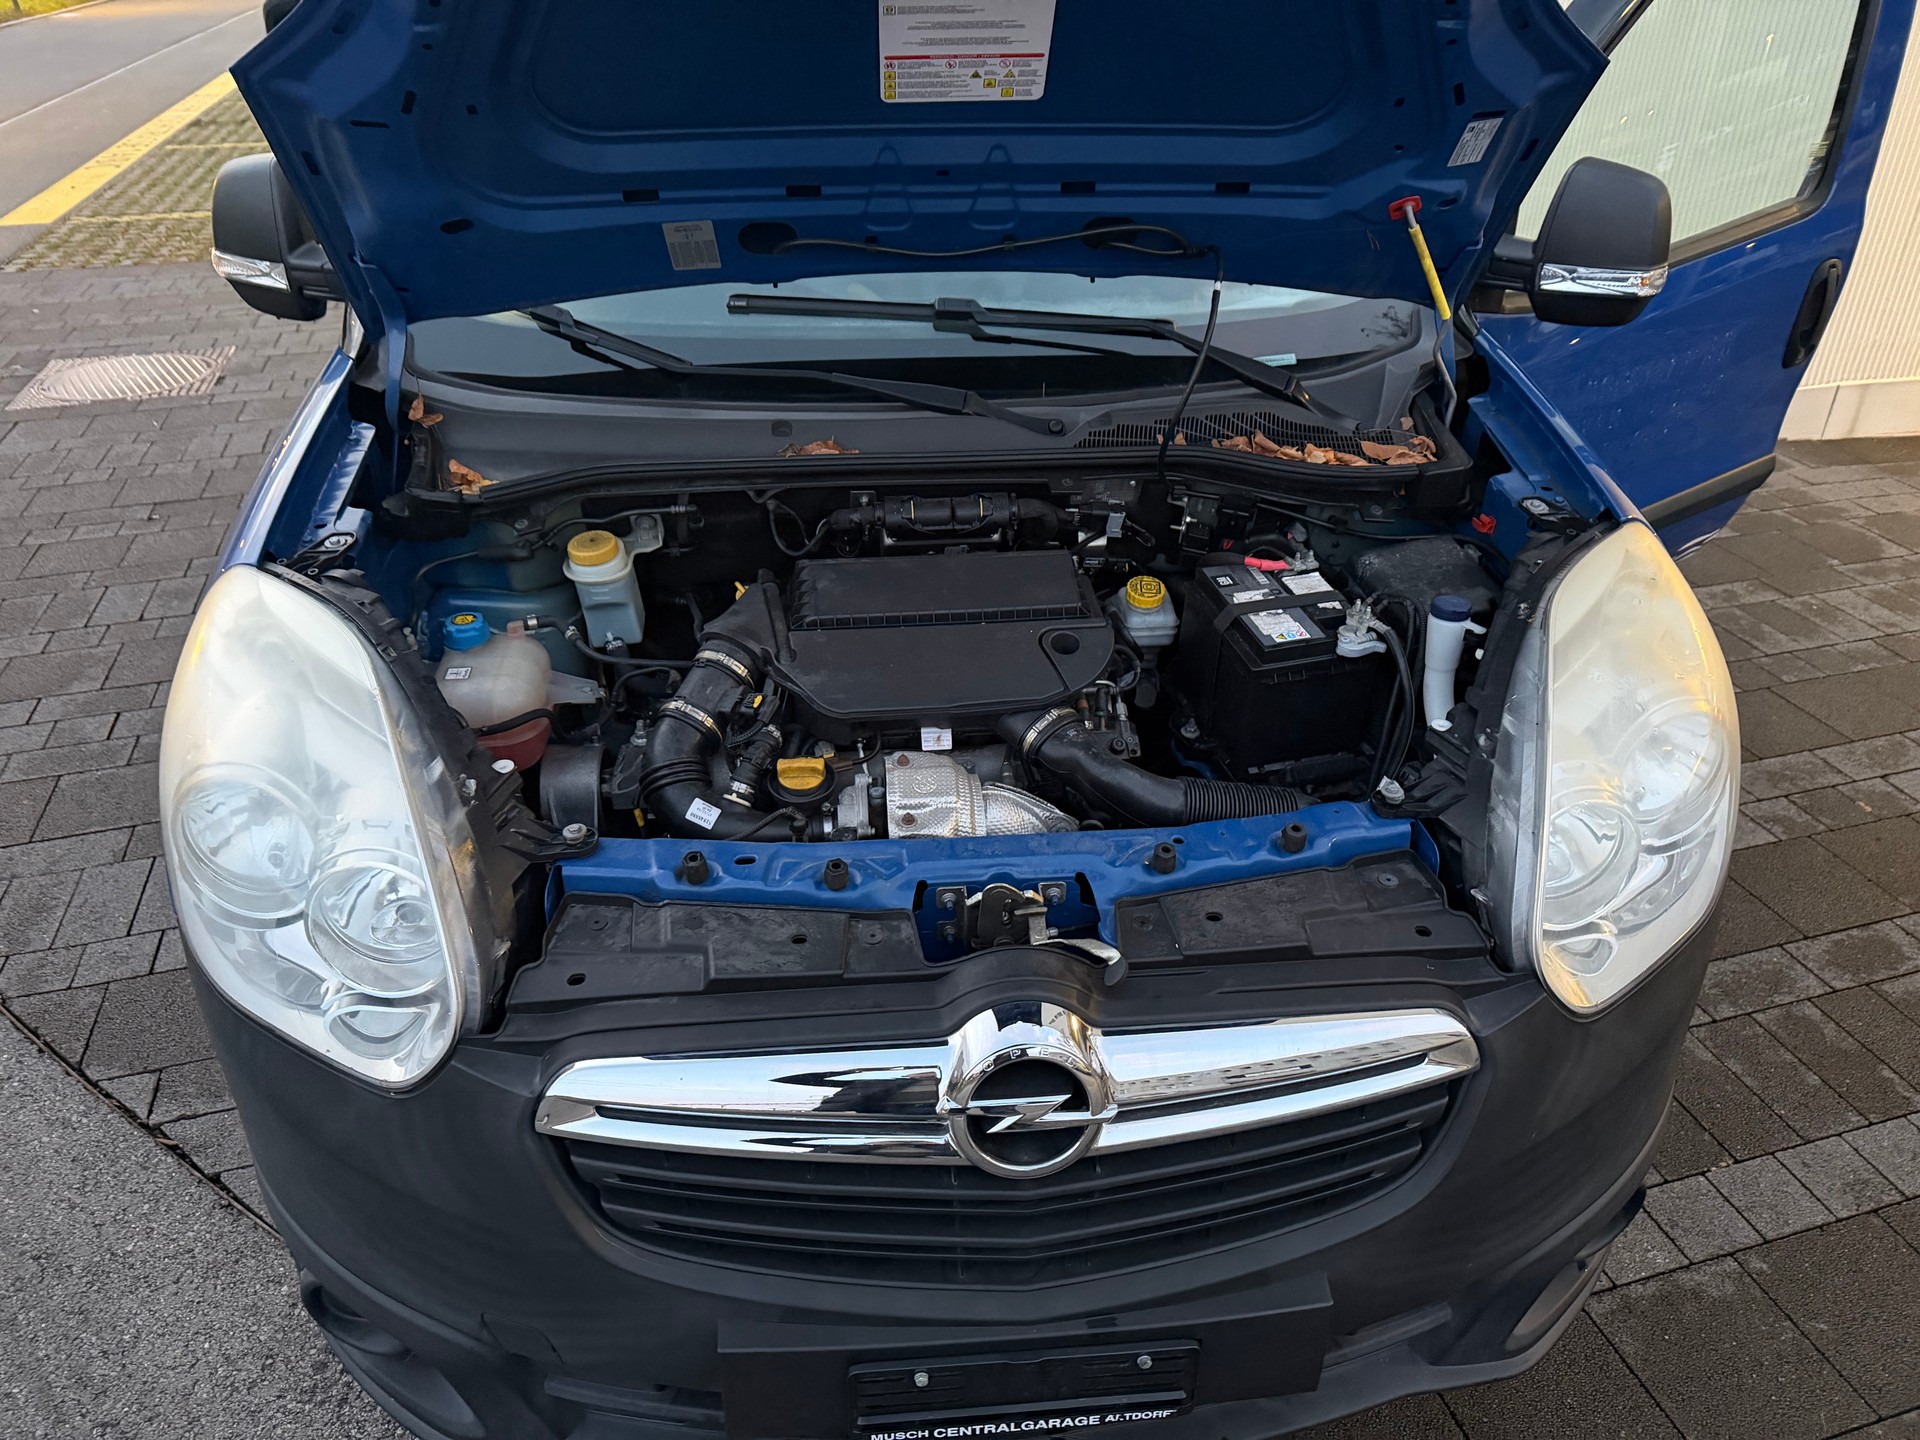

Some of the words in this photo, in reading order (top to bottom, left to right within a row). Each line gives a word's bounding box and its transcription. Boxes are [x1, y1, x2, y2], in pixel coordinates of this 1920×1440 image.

[982, 1047, 1077, 1072] OPEL
[871, 1430, 929, 1440] MUSCH
[933, 1415, 1101, 1438] CENTRALGARAGE
